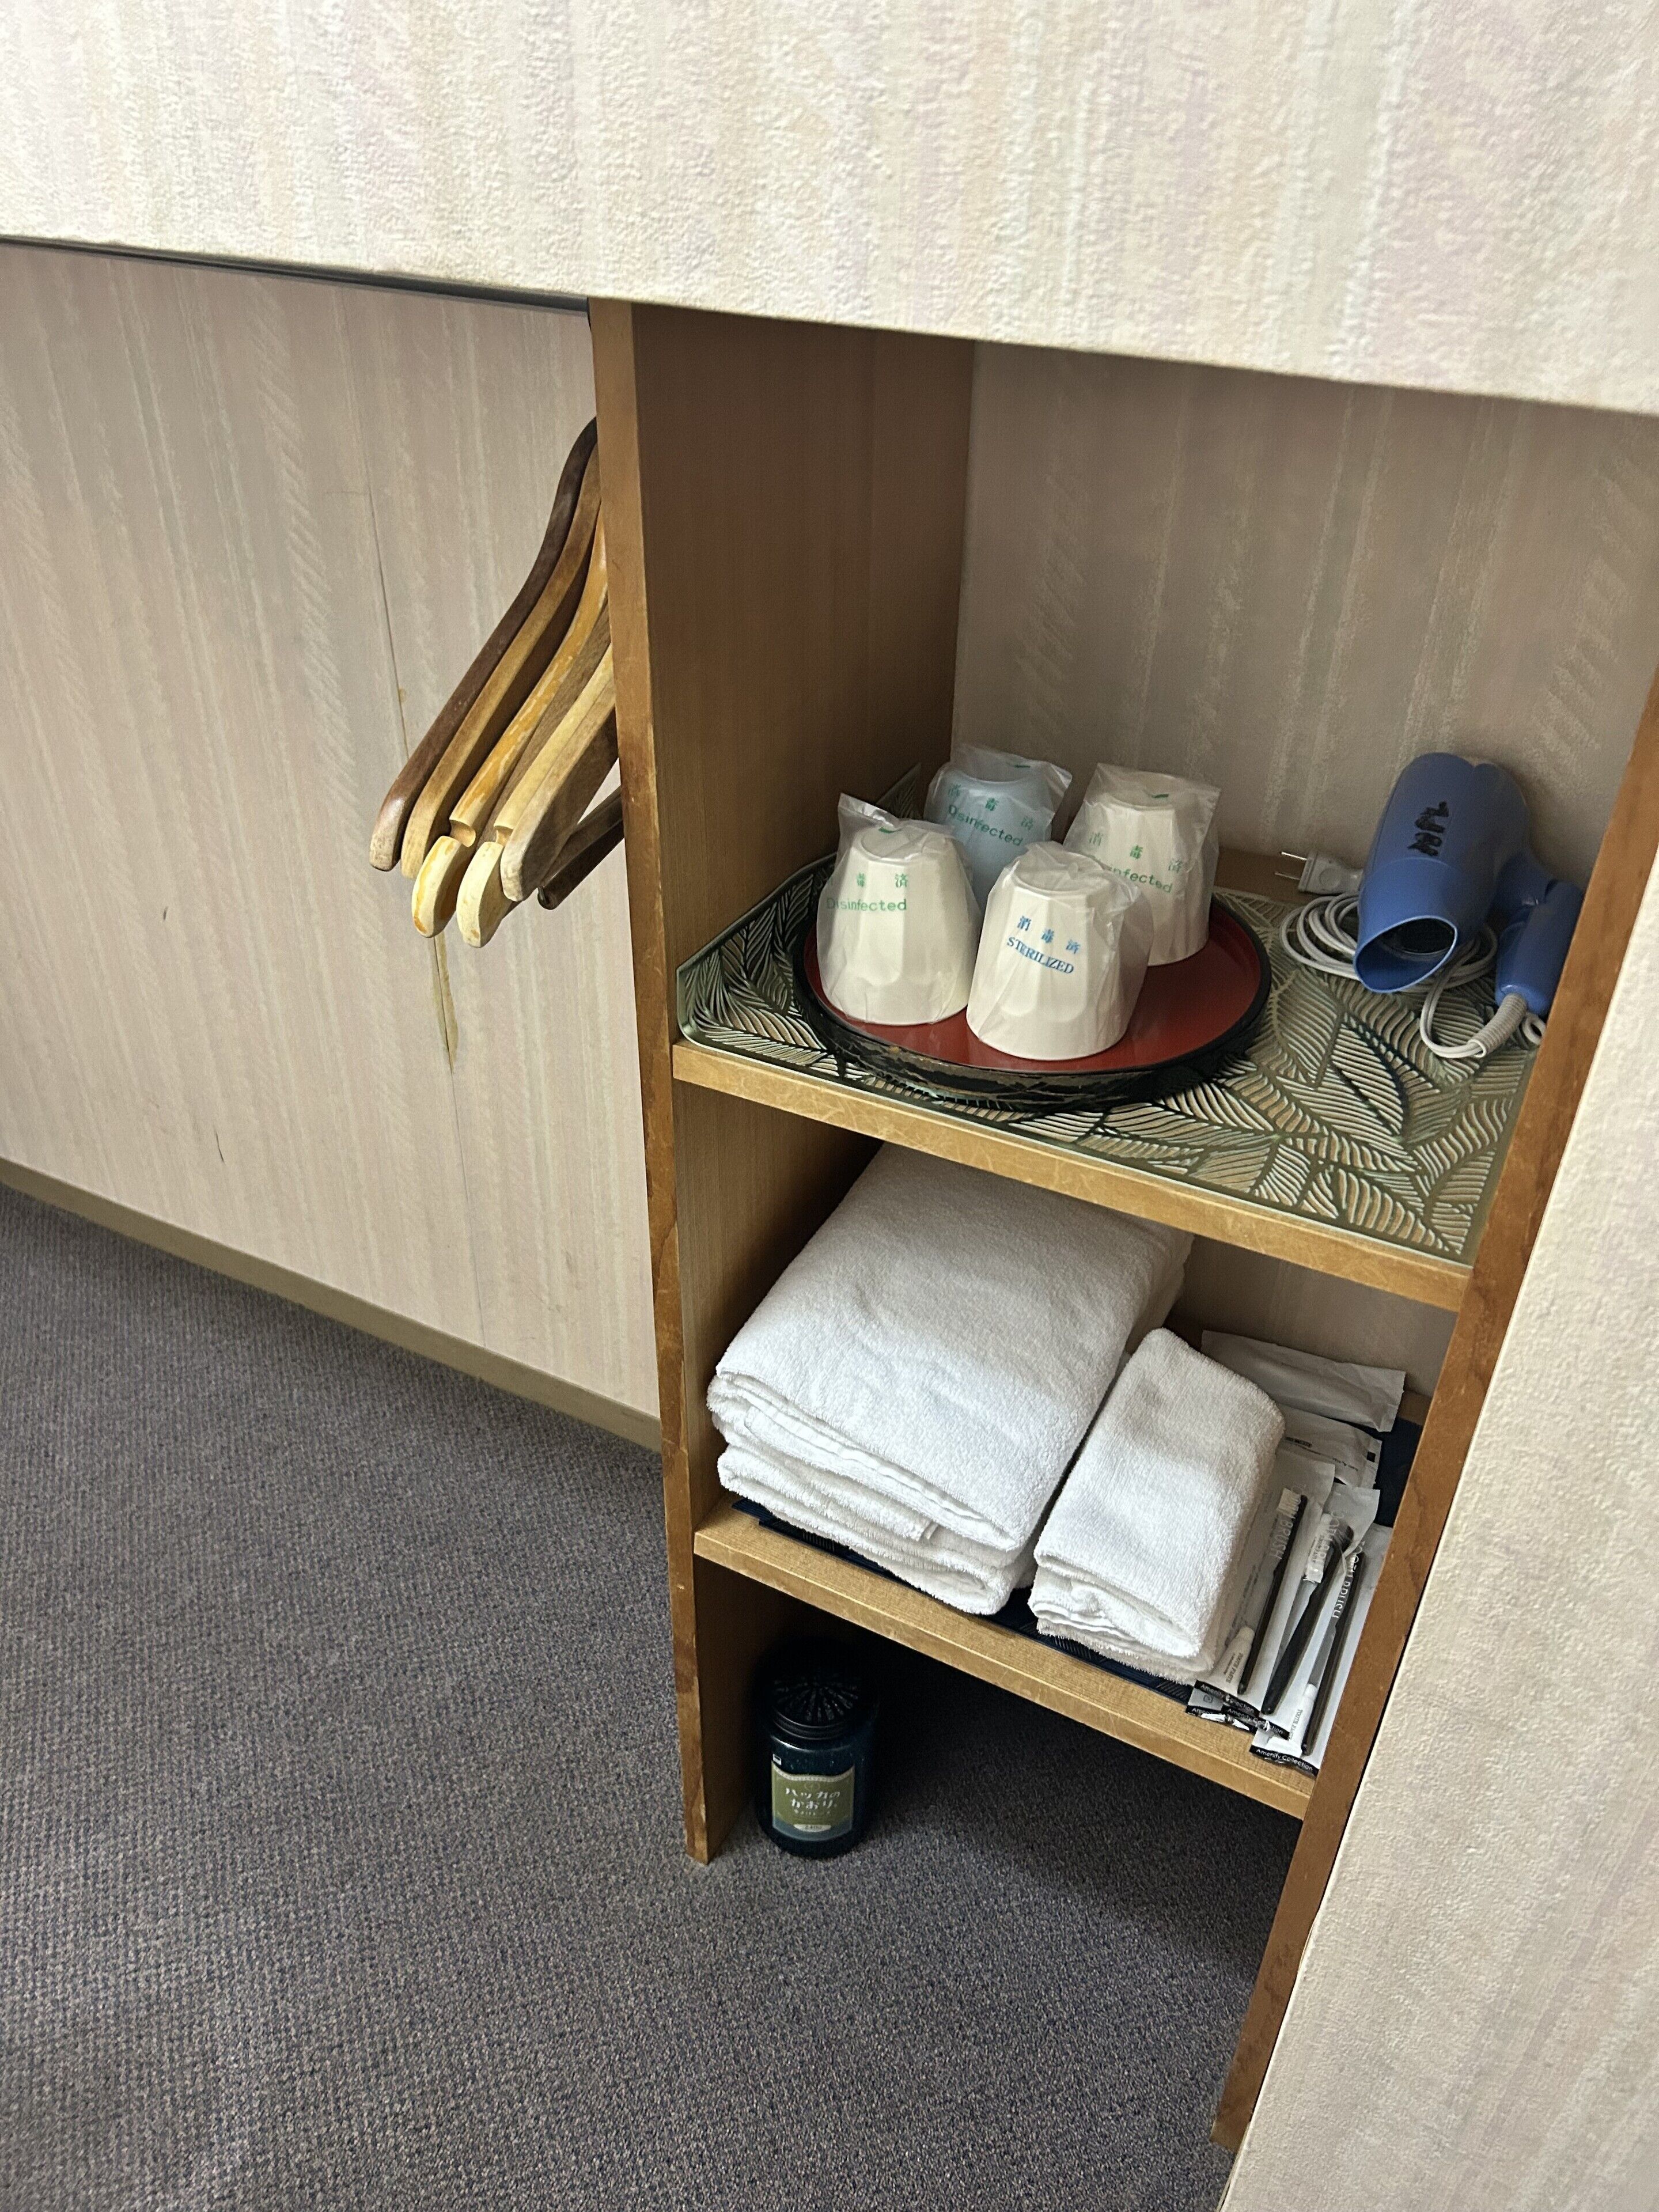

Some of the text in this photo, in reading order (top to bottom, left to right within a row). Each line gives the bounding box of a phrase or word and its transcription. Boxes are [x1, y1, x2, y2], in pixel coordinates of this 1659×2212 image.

[949, 805, 1023, 846] Dsinfected
[826, 897, 907, 911] Disinfected
[1007, 937, 1074, 974] STERILIZED
[1256, 1748, 1314, 1771] Amenity Collection
